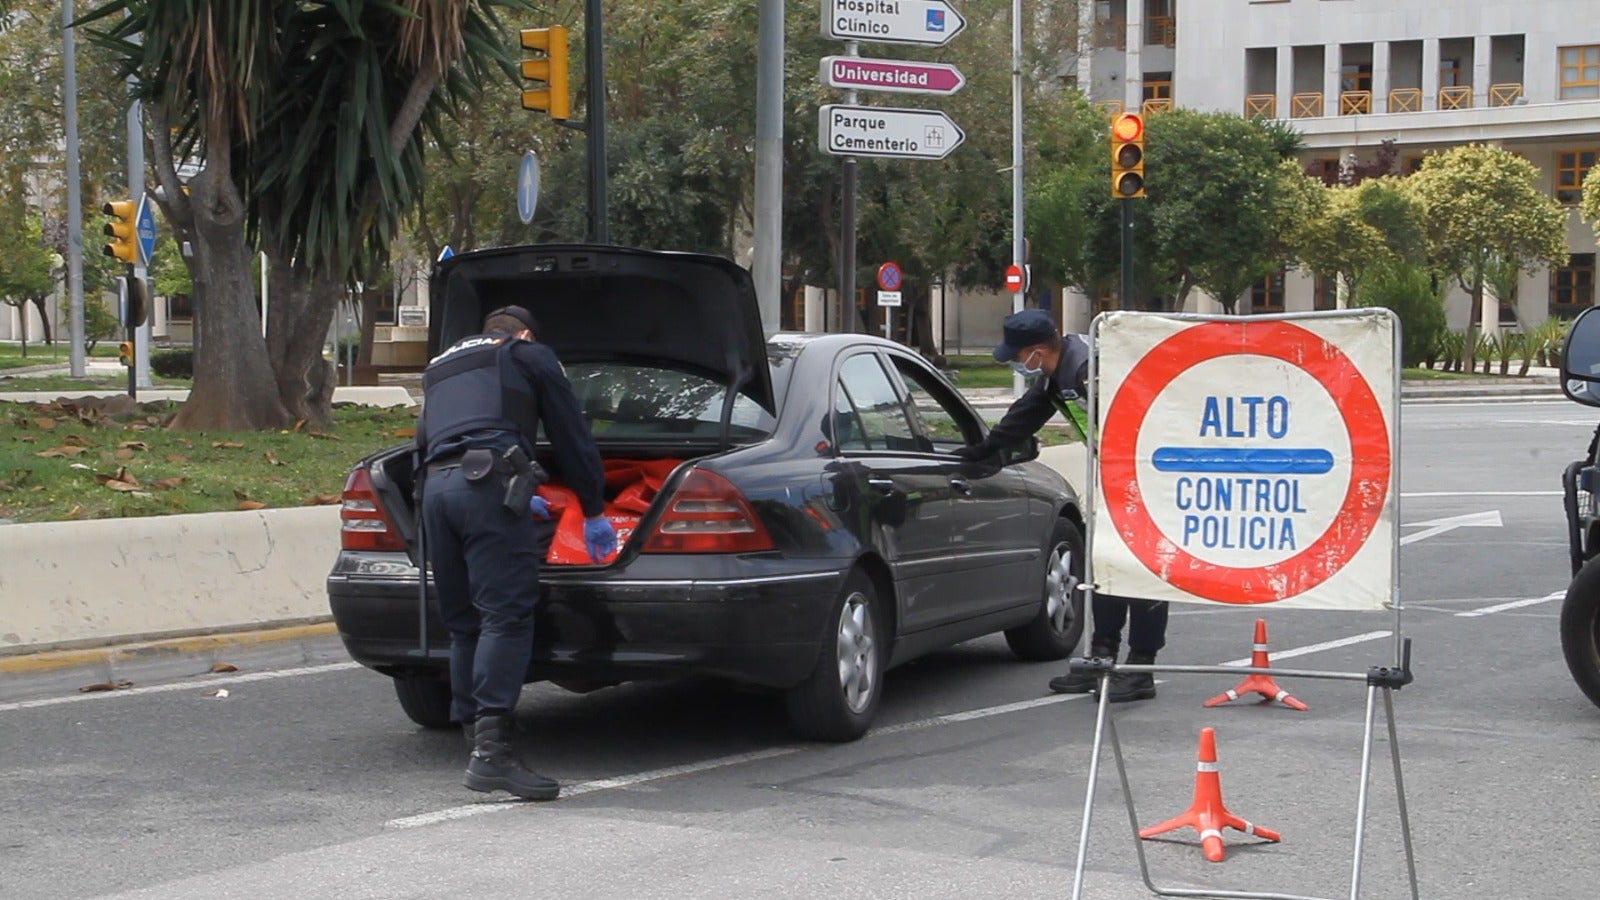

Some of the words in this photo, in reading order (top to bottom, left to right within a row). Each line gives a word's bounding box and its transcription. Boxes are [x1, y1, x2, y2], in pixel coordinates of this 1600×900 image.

[837, 0, 900, 16] Hospital
[834, 64, 928, 86] Universidad
[834, 113, 886, 131] Parque
[834, 134, 918, 152] Cementerio
[430, 337, 493, 364] LICIA
[1199, 395, 1289, 439] ALTO
[1176, 477, 1307, 513] CONTROL
[1183, 515, 1297, 550] POLICIA
